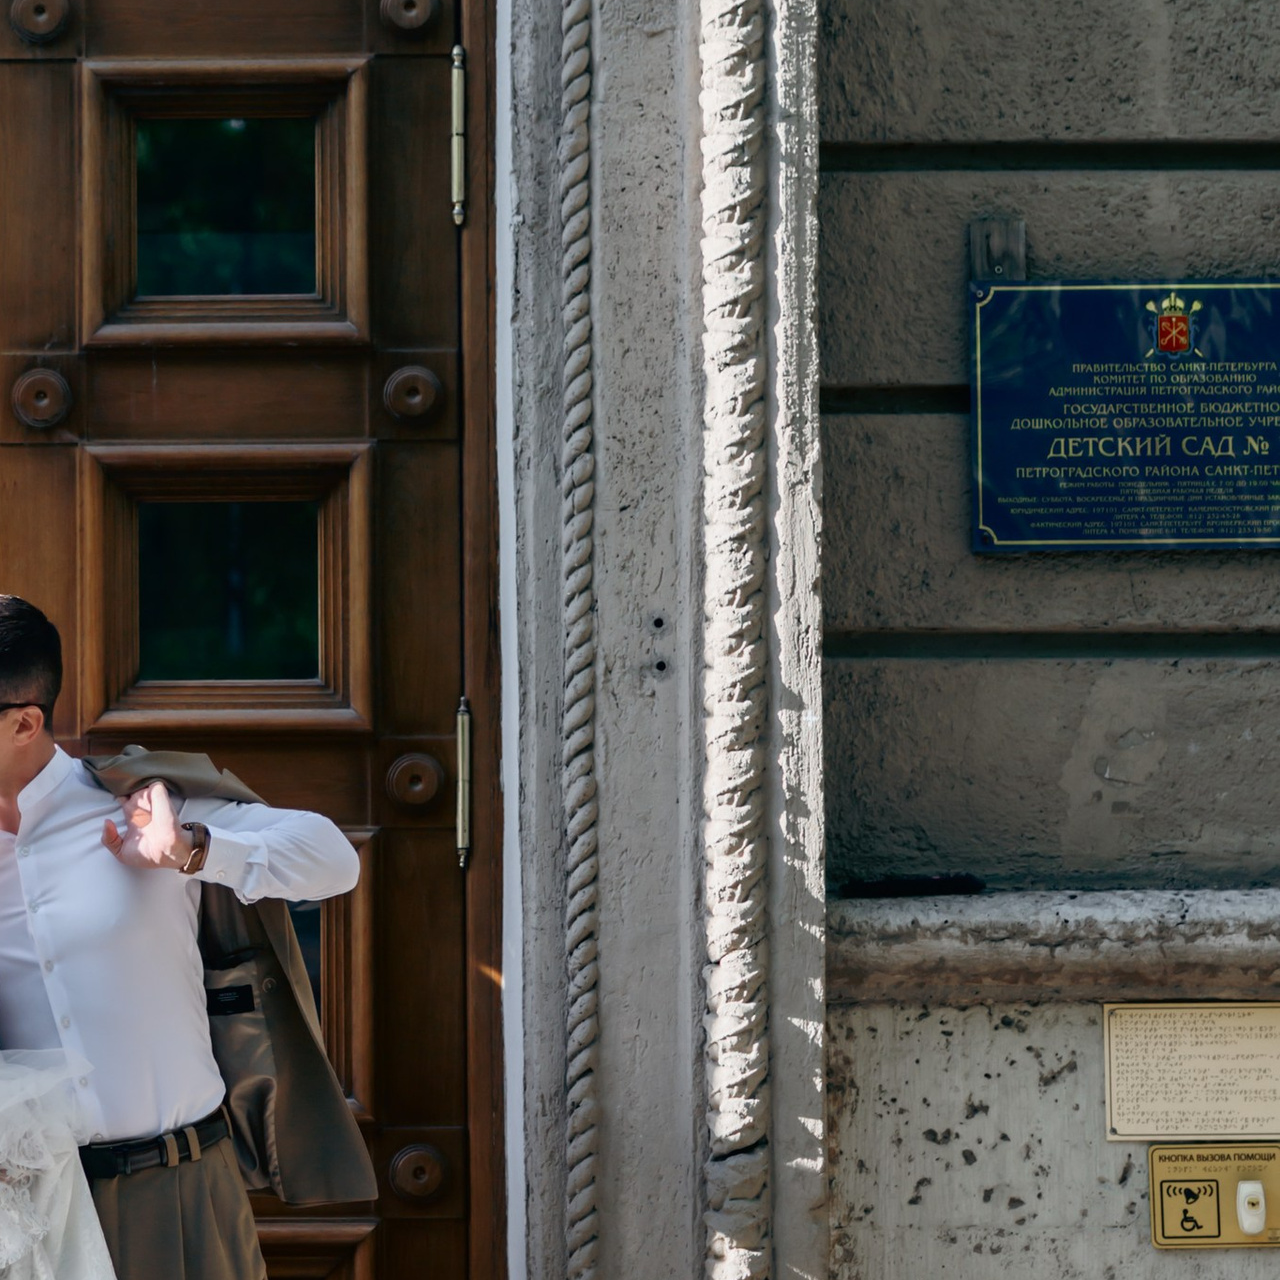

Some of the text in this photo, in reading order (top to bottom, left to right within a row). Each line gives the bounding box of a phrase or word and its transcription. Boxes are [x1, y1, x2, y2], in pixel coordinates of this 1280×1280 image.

[1072, 361, 1277, 373] ПРАВИТЕЛЬСТВО САНКТ-ПЕТЕРБУРГА
[1093, 373, 1257, 384] КОМИТЕТ ПО ОБРАЗОВАНИЮ
[1048, 386, 1147, 397] АДМИНИСТРАЦИЯ
[1151, 385, 1252, 396] ПЕТРОГРАДСКОГО
[1063, 403, 1195, 415] ГОСУДАРСТВЕННОЕ
[1010, 417, 1108, 430] ДОШКОЛЬНОЕ
[1112, 416, 1243, 428] ОБРАЗОВАТЕЛЬНОЕ
[1046, 434, 1270, 460] ДЕТСКИЙ САД №
[1016, 466, 1140, 478] ПЕТРОГРАДСКОГО
[1145, 464, 1200, 476] РАЙОНА
[1158, 1153, 1276, 1162] КНОПКА ВЫЗОВА ПОМОЩИ
